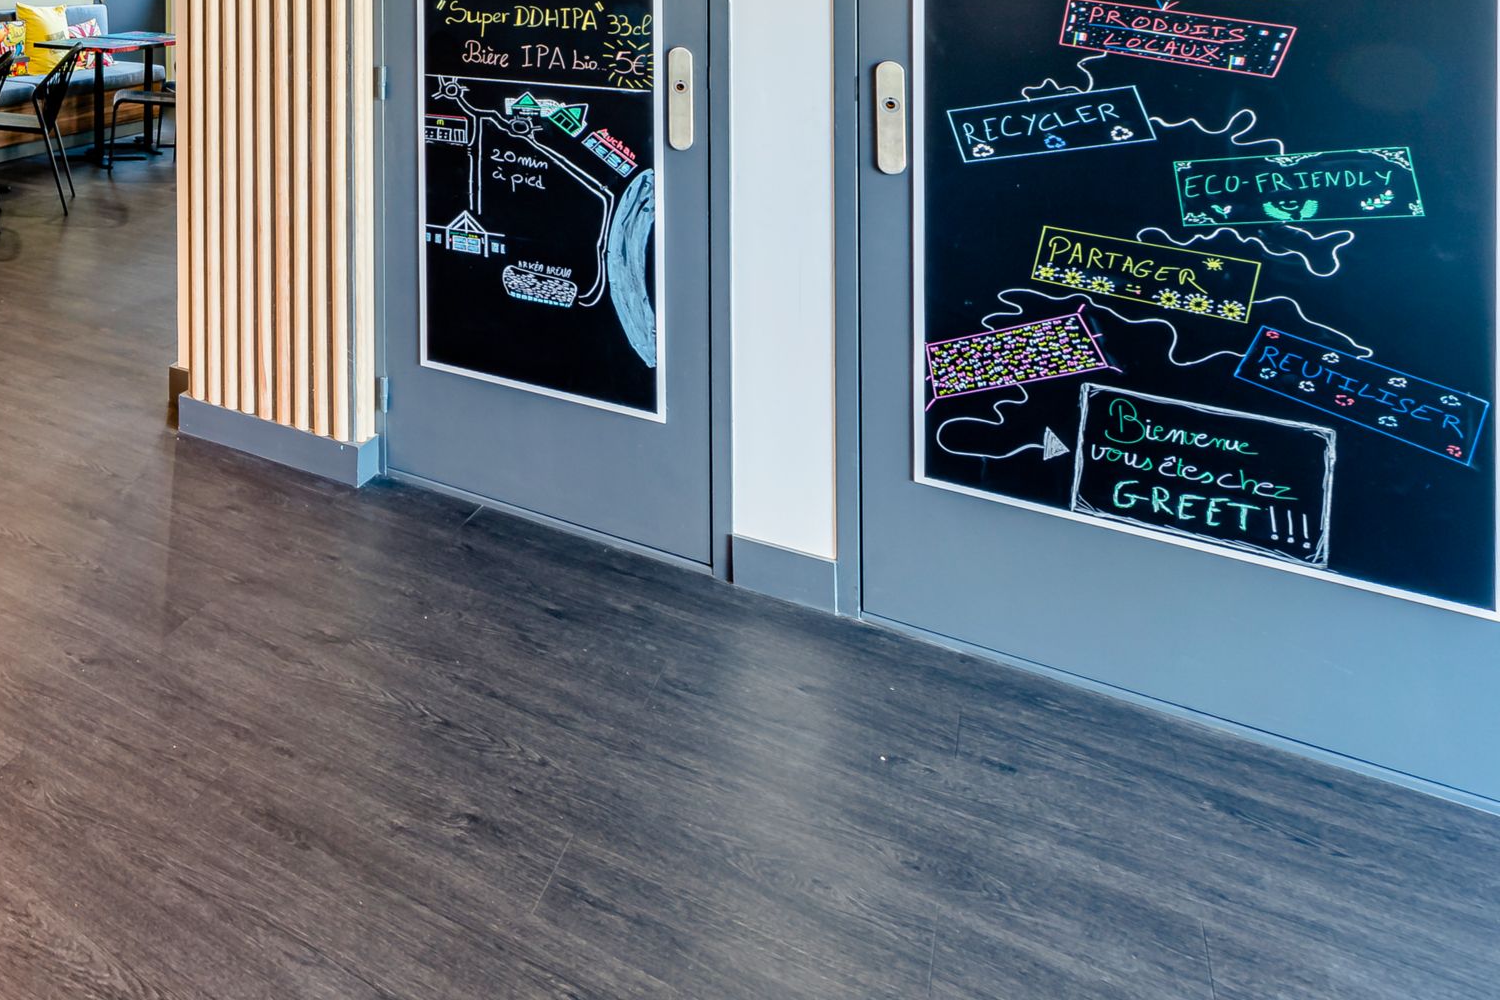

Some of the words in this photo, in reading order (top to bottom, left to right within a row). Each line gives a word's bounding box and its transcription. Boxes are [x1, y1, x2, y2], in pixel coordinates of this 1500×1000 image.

[1086, 4, 1248, 44] PRODUITS
[461, 39, 509, 68] Bière
[520, 43, 567, 71] IPA
[1101, 31, 1223, 63] LOCAUX
[961, 101, 1122, 146] RECYCLER
[596, 128, 637, 161] Auchan
[491, 166, 506, 180] à
[511, 172, 546, 192] pied
[1184, 168, 1394, 200] ECO-FRIENDLY
[1047, 234, 1208, 295] PARTAGER
[1258, 345, 1464, 439] REUTILISER
[1104, 398, 1259, 455] Bienvenue
[1091, 444, 1154, 472] vous
[1158, 456, 1215, 484] êtes
[1216, 469, 1299, 501] chez
